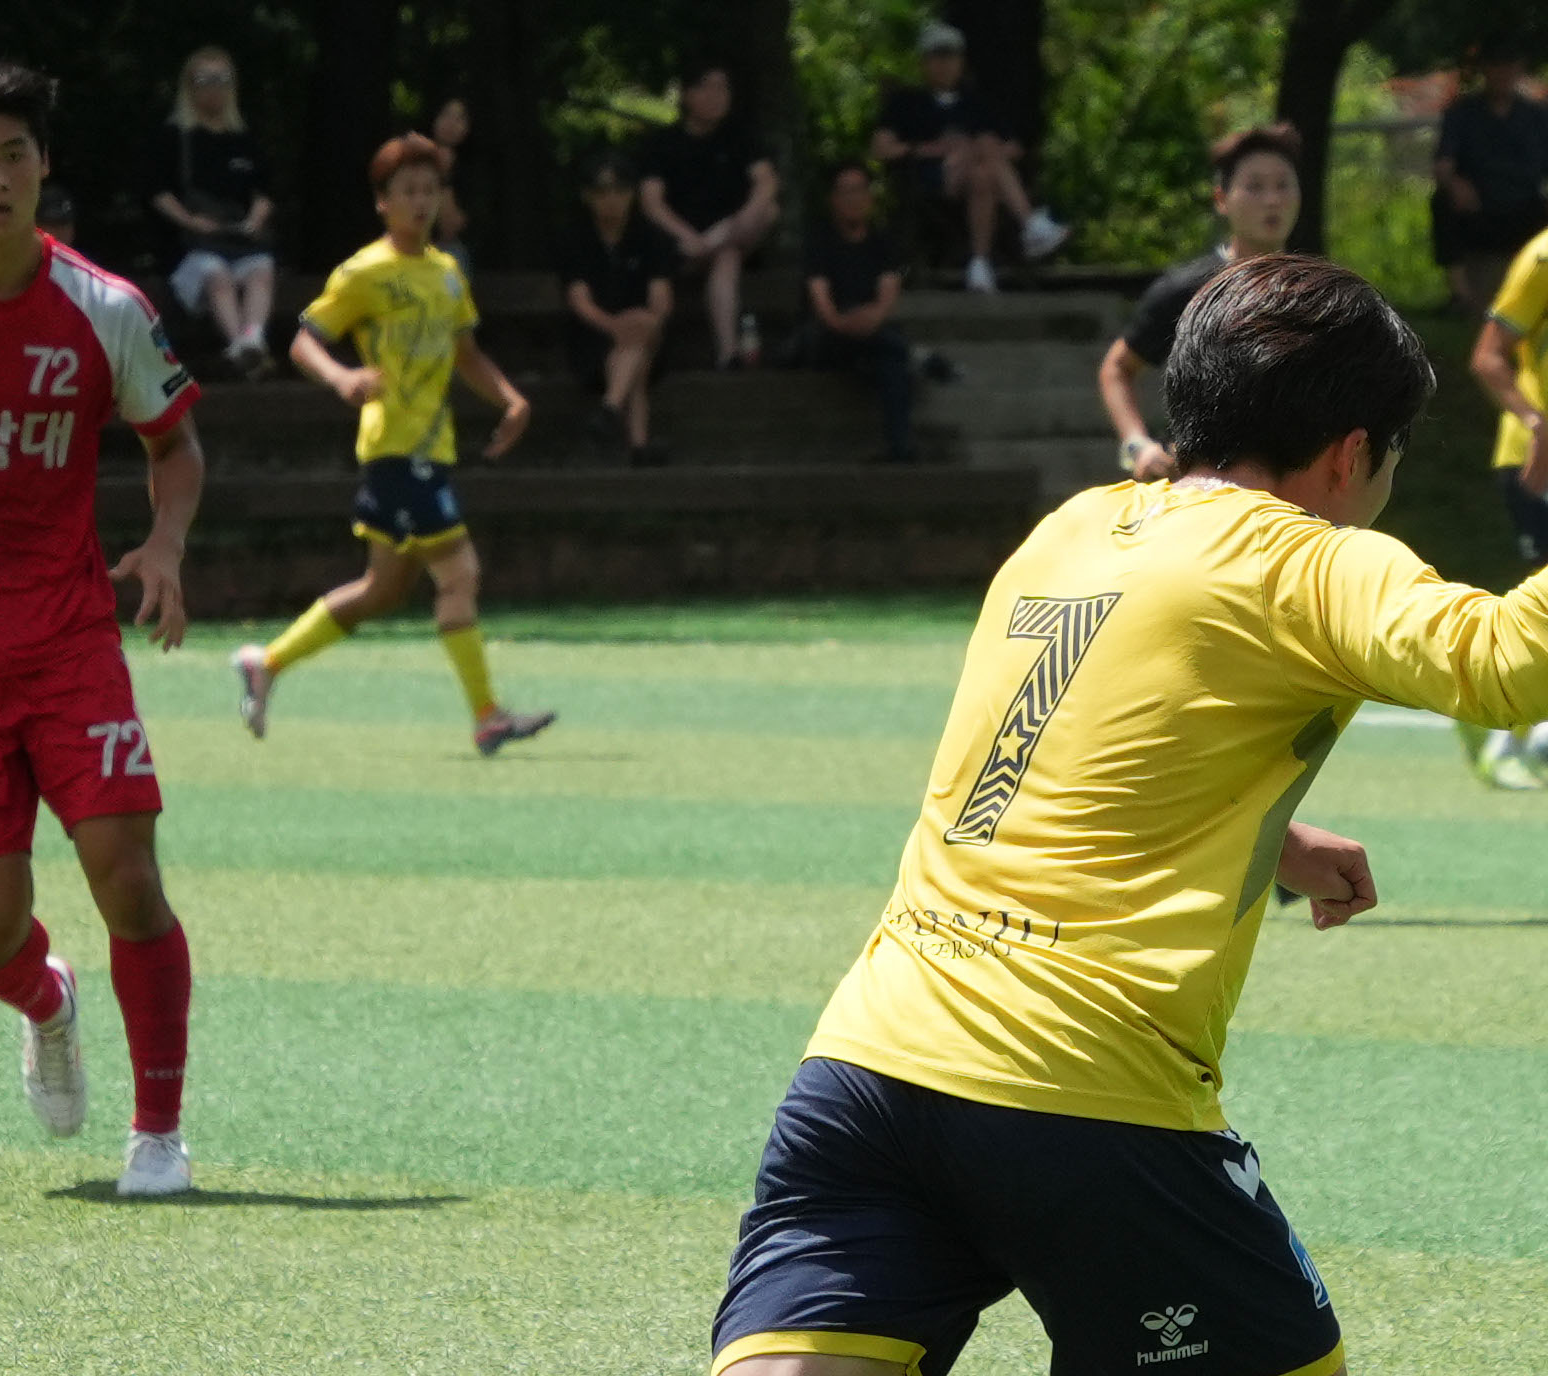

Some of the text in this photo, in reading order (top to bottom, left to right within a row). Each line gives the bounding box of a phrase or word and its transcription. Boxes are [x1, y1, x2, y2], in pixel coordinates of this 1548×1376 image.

[23, 344, 79, 397] 72
[943, 591, 1123, 846] 7
[86, 719, 155, 778] 72
[1136, 1339, 1209, 1367] hummel
